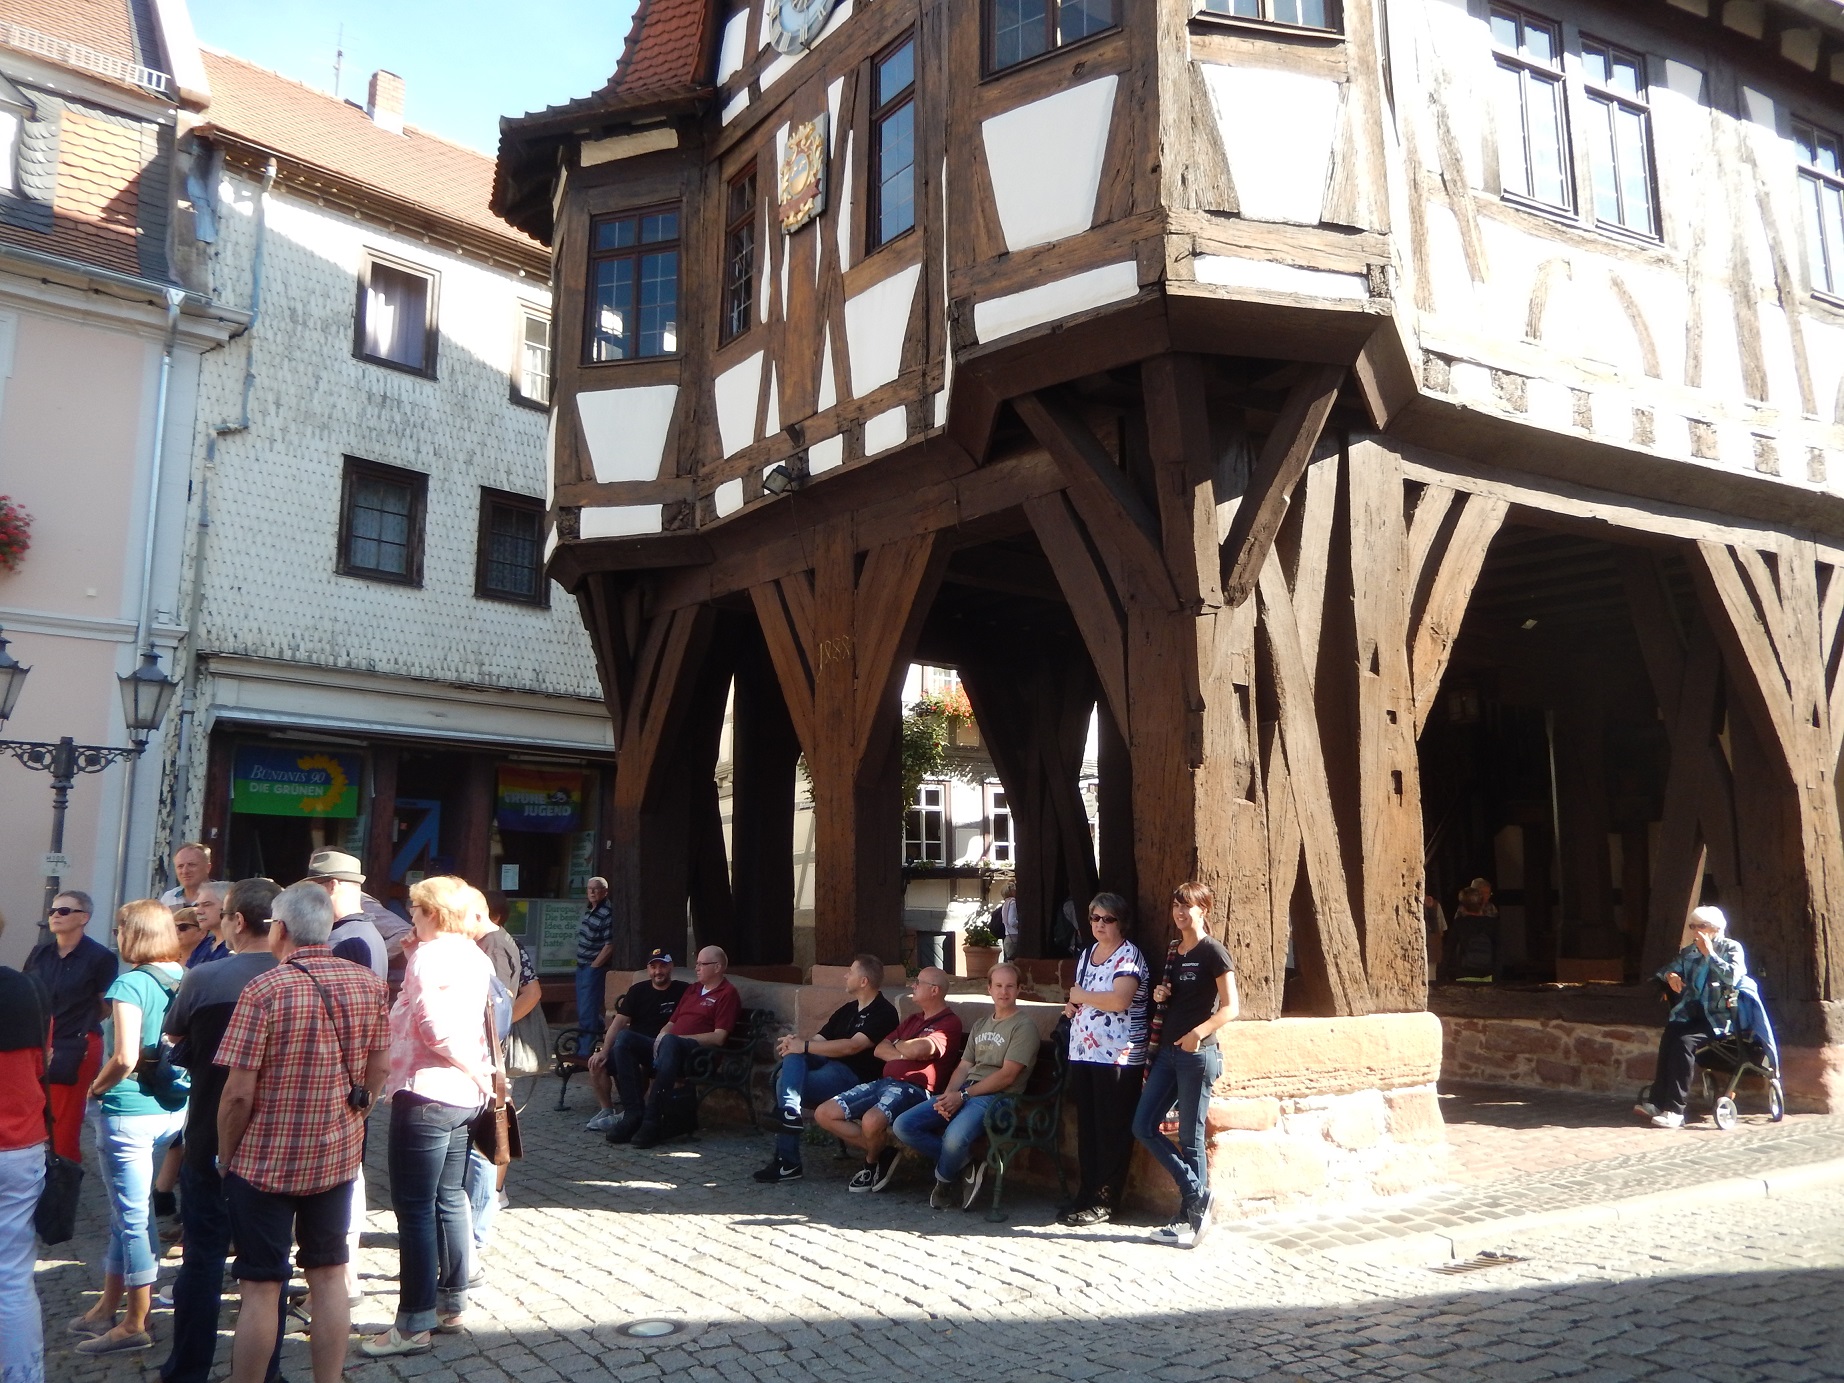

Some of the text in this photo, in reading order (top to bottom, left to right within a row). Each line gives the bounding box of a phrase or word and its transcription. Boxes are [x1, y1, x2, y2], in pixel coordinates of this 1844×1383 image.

[310, 771, 326, 783] 90
[249, 782, 324, 796] DIE GRÜNEN
[523, 805, 572, 817] JUGEND
[544, 930, 573, 940] Europa
